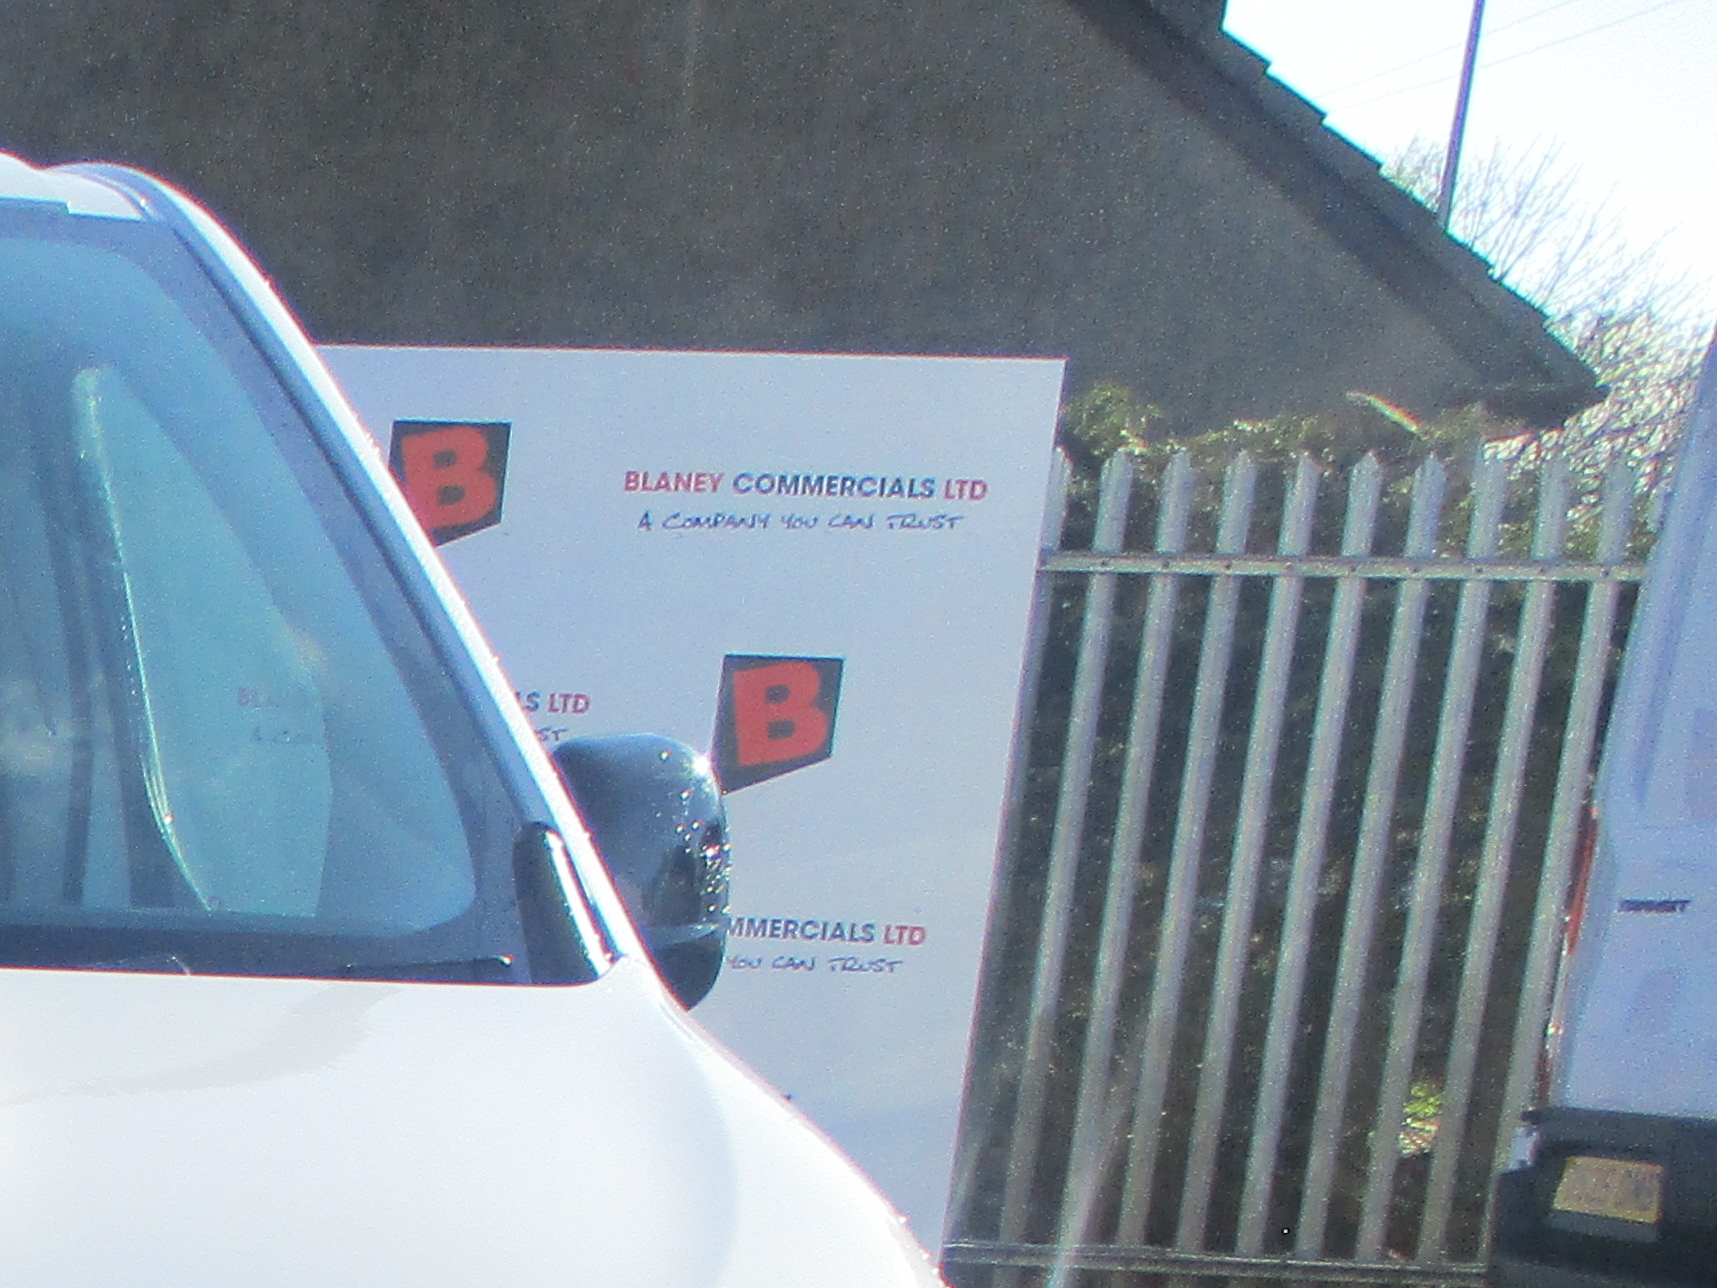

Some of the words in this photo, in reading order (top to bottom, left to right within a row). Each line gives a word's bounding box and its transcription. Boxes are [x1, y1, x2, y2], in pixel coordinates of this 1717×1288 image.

[402, 426, 496, 526] B
[624, 470, 724, 493] BLANEY
[732, 472, 936, 499] COMMERCIALS
[943, 479, 989, 500] LTD
[638, 510, 653, 531] A
[662, 512, 770, 530] COMPANY
[780, 513, 819, 529] YOU
[827, 513, 875, 530] CAN
[886, 513, 965, 530] TRUST
[547, 692, 591, 713] LTD
[732, 661, 827, 766] B
[883, 924, 928, 946] LTD
[772, 955, 816, 972] CAN
[827, 956, 903, 973] TRUST
